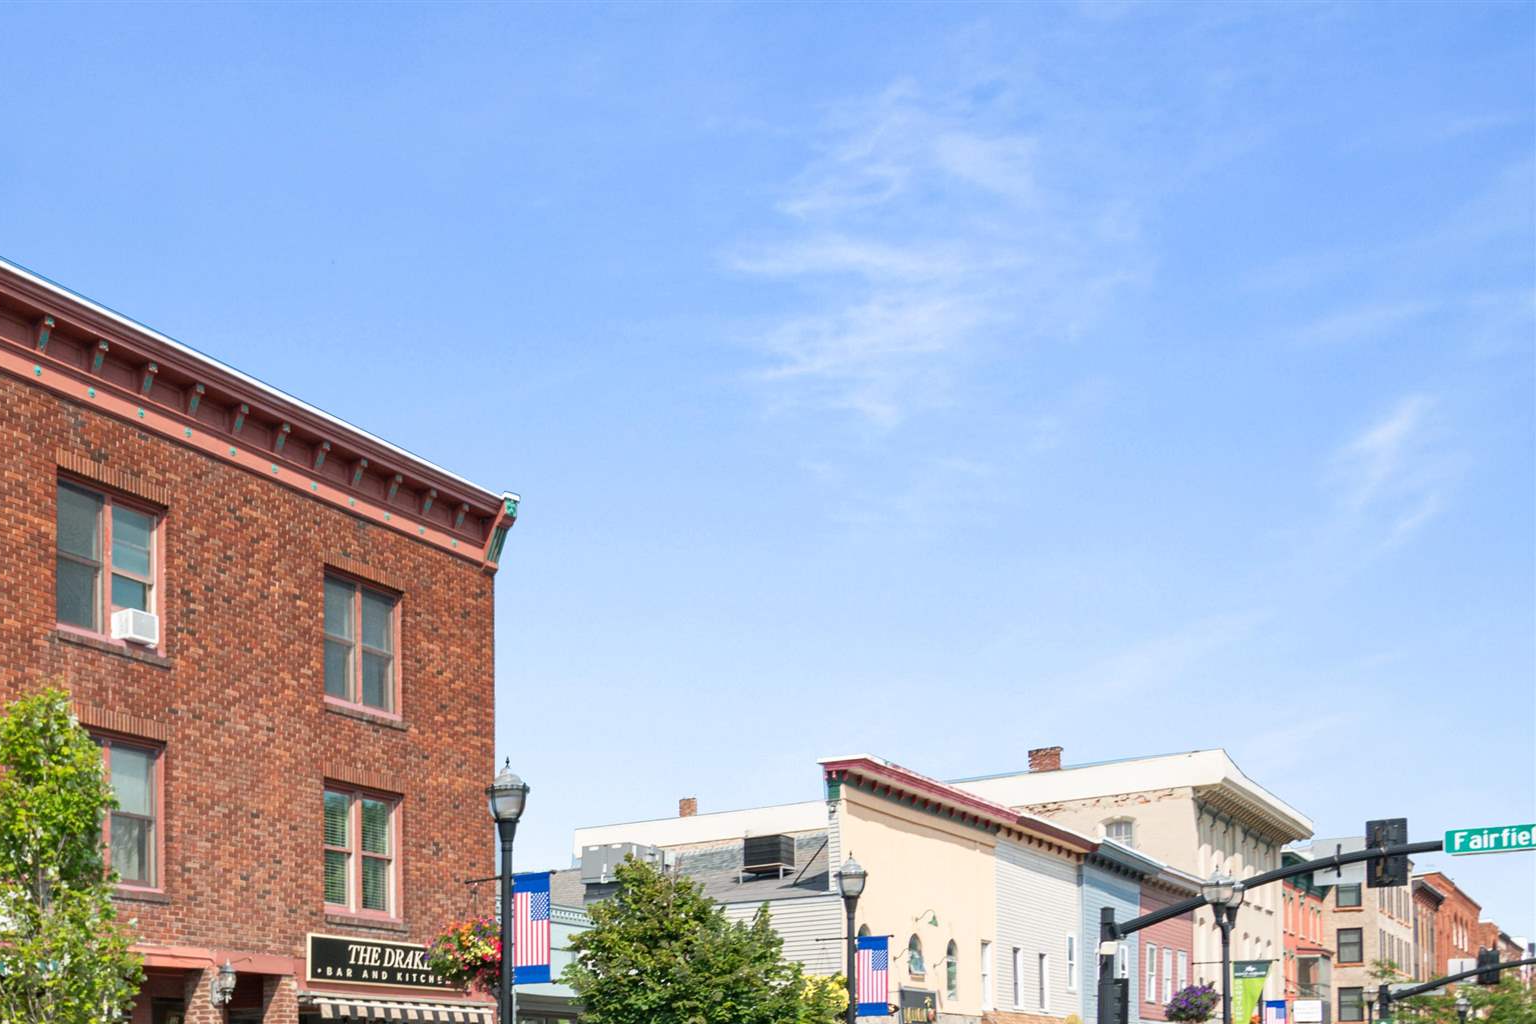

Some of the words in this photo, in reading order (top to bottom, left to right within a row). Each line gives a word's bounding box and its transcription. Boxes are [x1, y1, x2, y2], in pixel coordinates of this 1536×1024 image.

[348, 944, 382, 967] THE
[326, 966, 353, 978] BAR
[362, 969, 389, 981] AND
